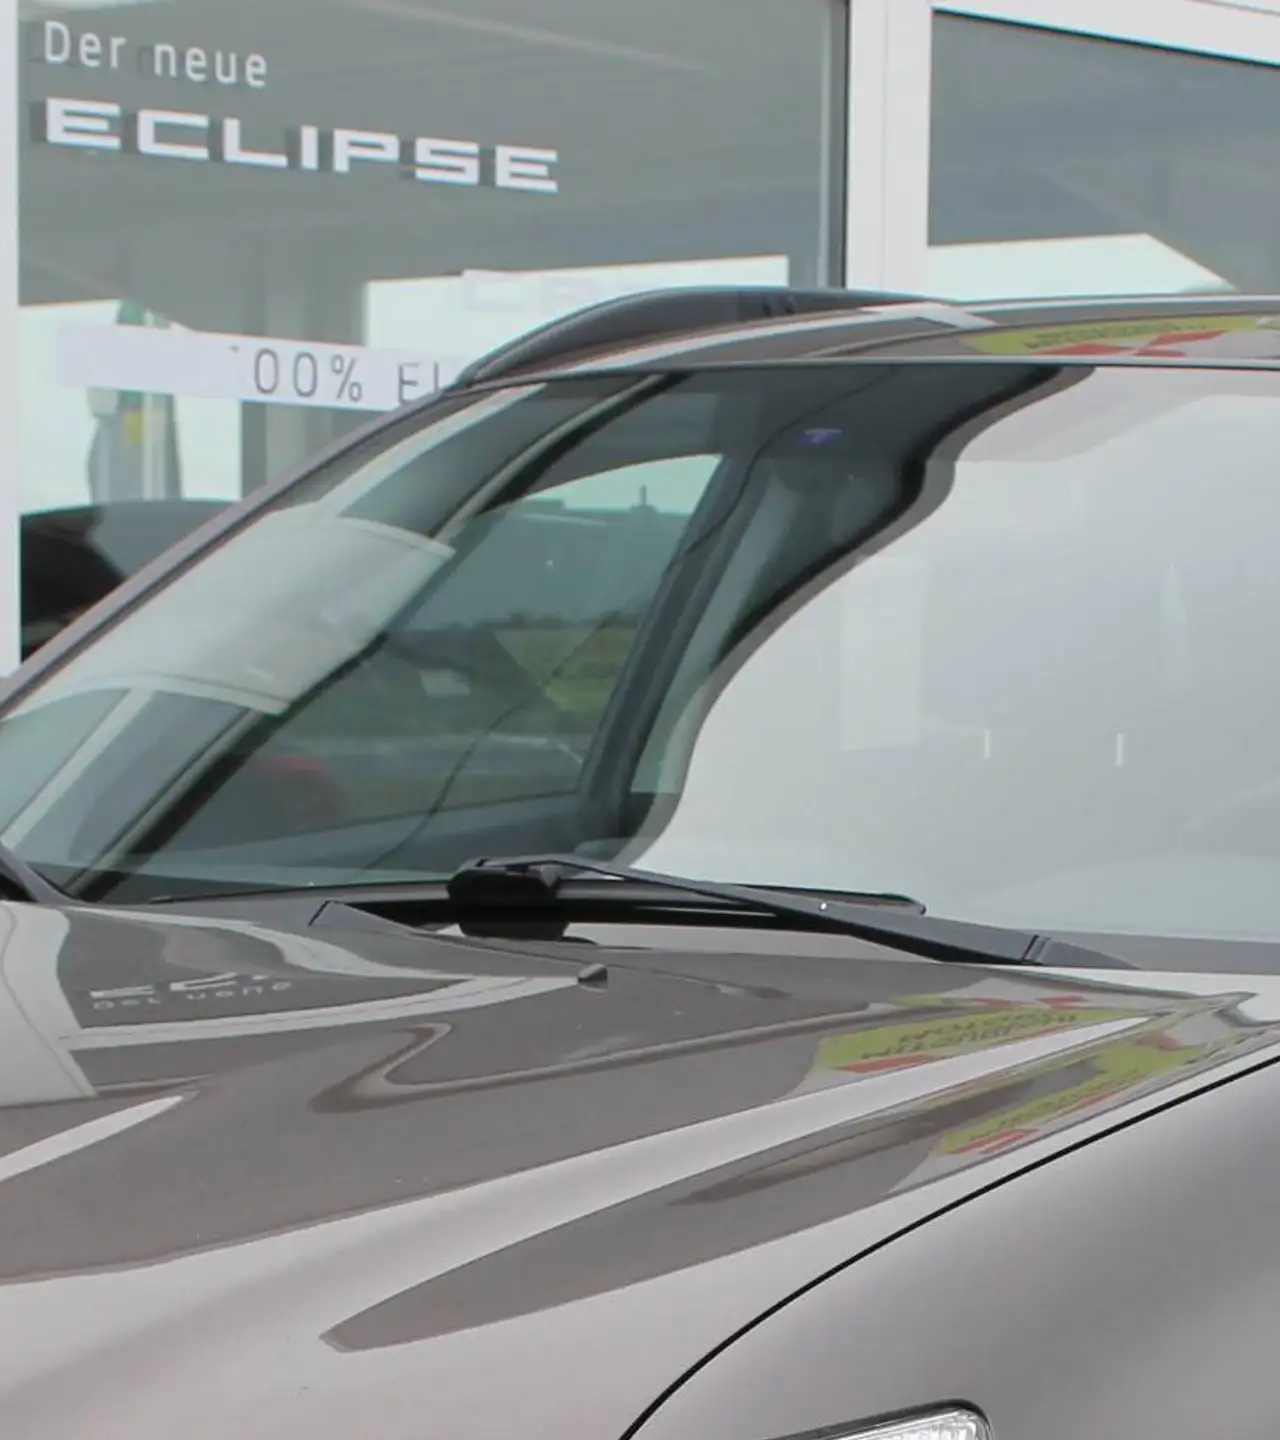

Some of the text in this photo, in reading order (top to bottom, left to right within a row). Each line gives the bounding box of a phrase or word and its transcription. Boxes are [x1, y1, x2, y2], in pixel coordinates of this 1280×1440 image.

[44, 20, 268, 88] Der neue
[46, 97, 558, 194] ECLIPSE
[229, 345, 363, 402] 00%
